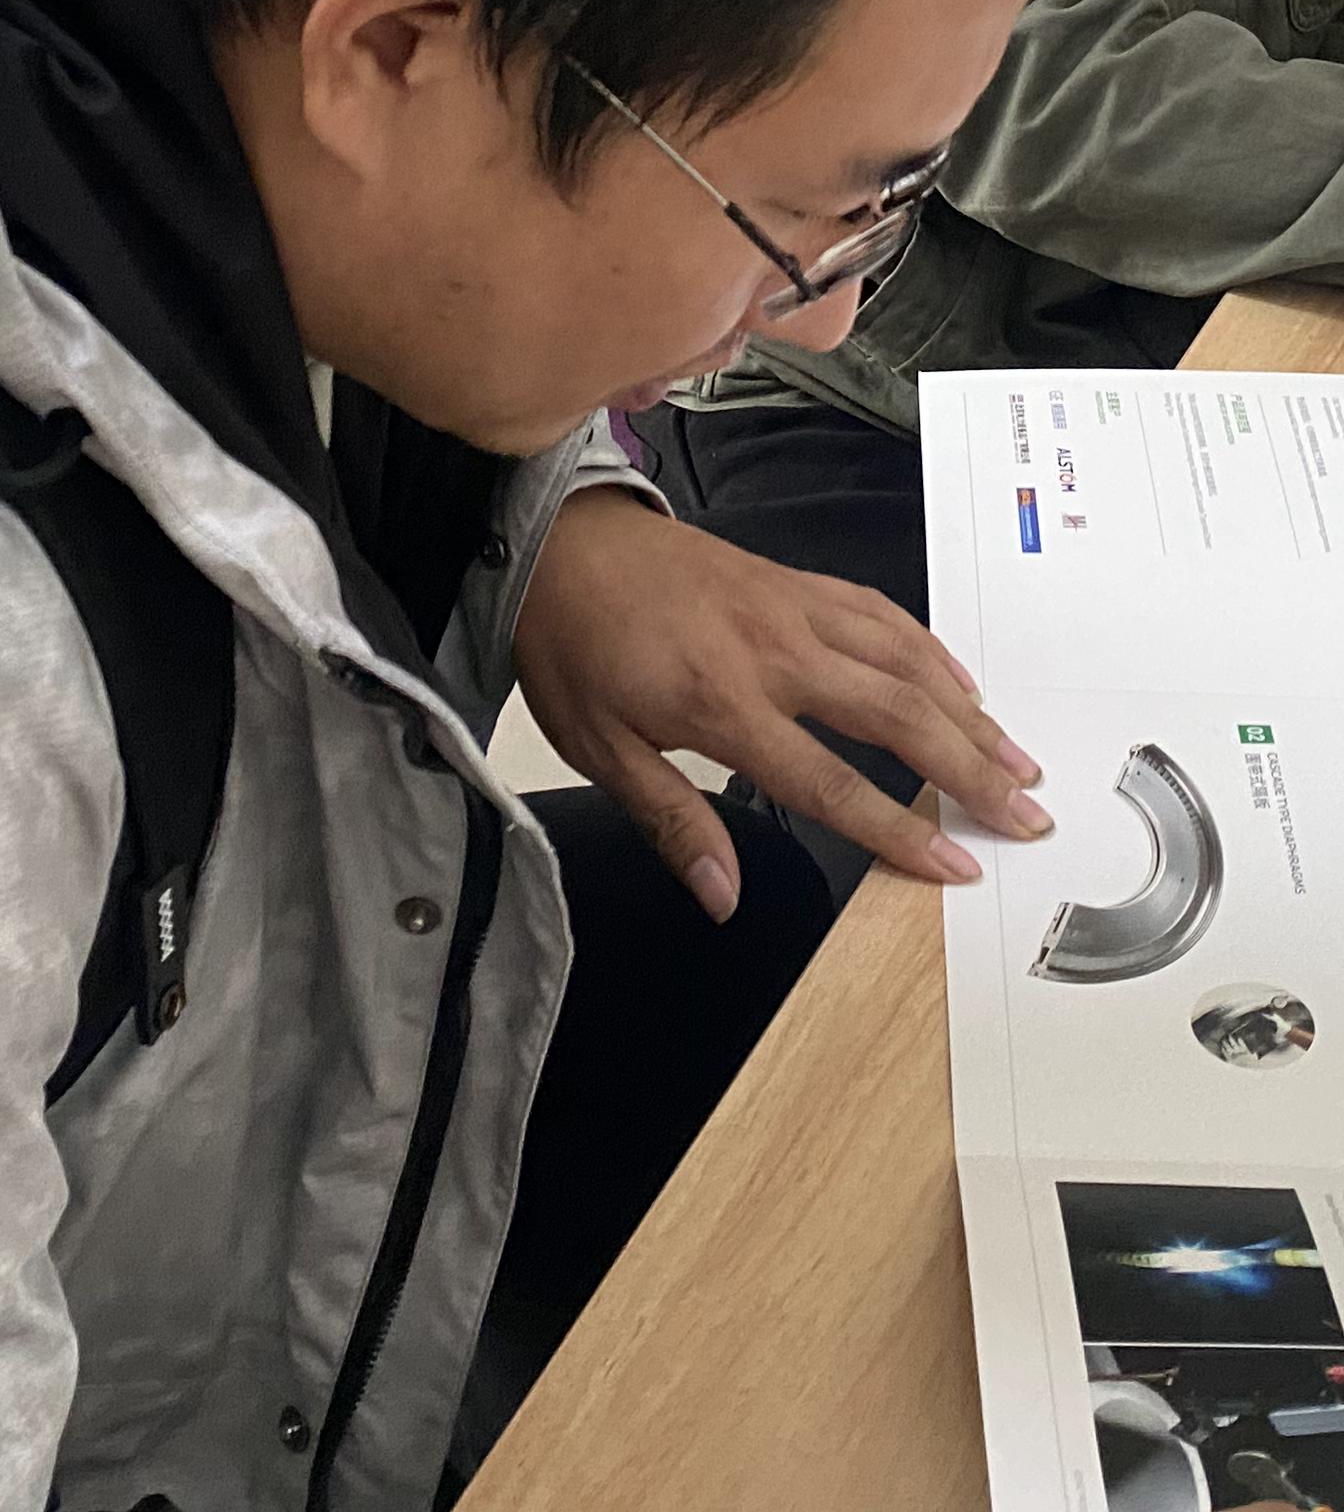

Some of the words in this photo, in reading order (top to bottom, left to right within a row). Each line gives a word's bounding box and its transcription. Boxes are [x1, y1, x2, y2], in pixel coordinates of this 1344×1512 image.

[1056, 447, 1077, 493] ALSTOM
[1246, 726, 1267, 742] 02
[1266, 752, 1287, 797] CASCADE
[1276, 797, 1292, 825] TYPE
[1281, 824, 1307, 895] DIAPHRAGMS
